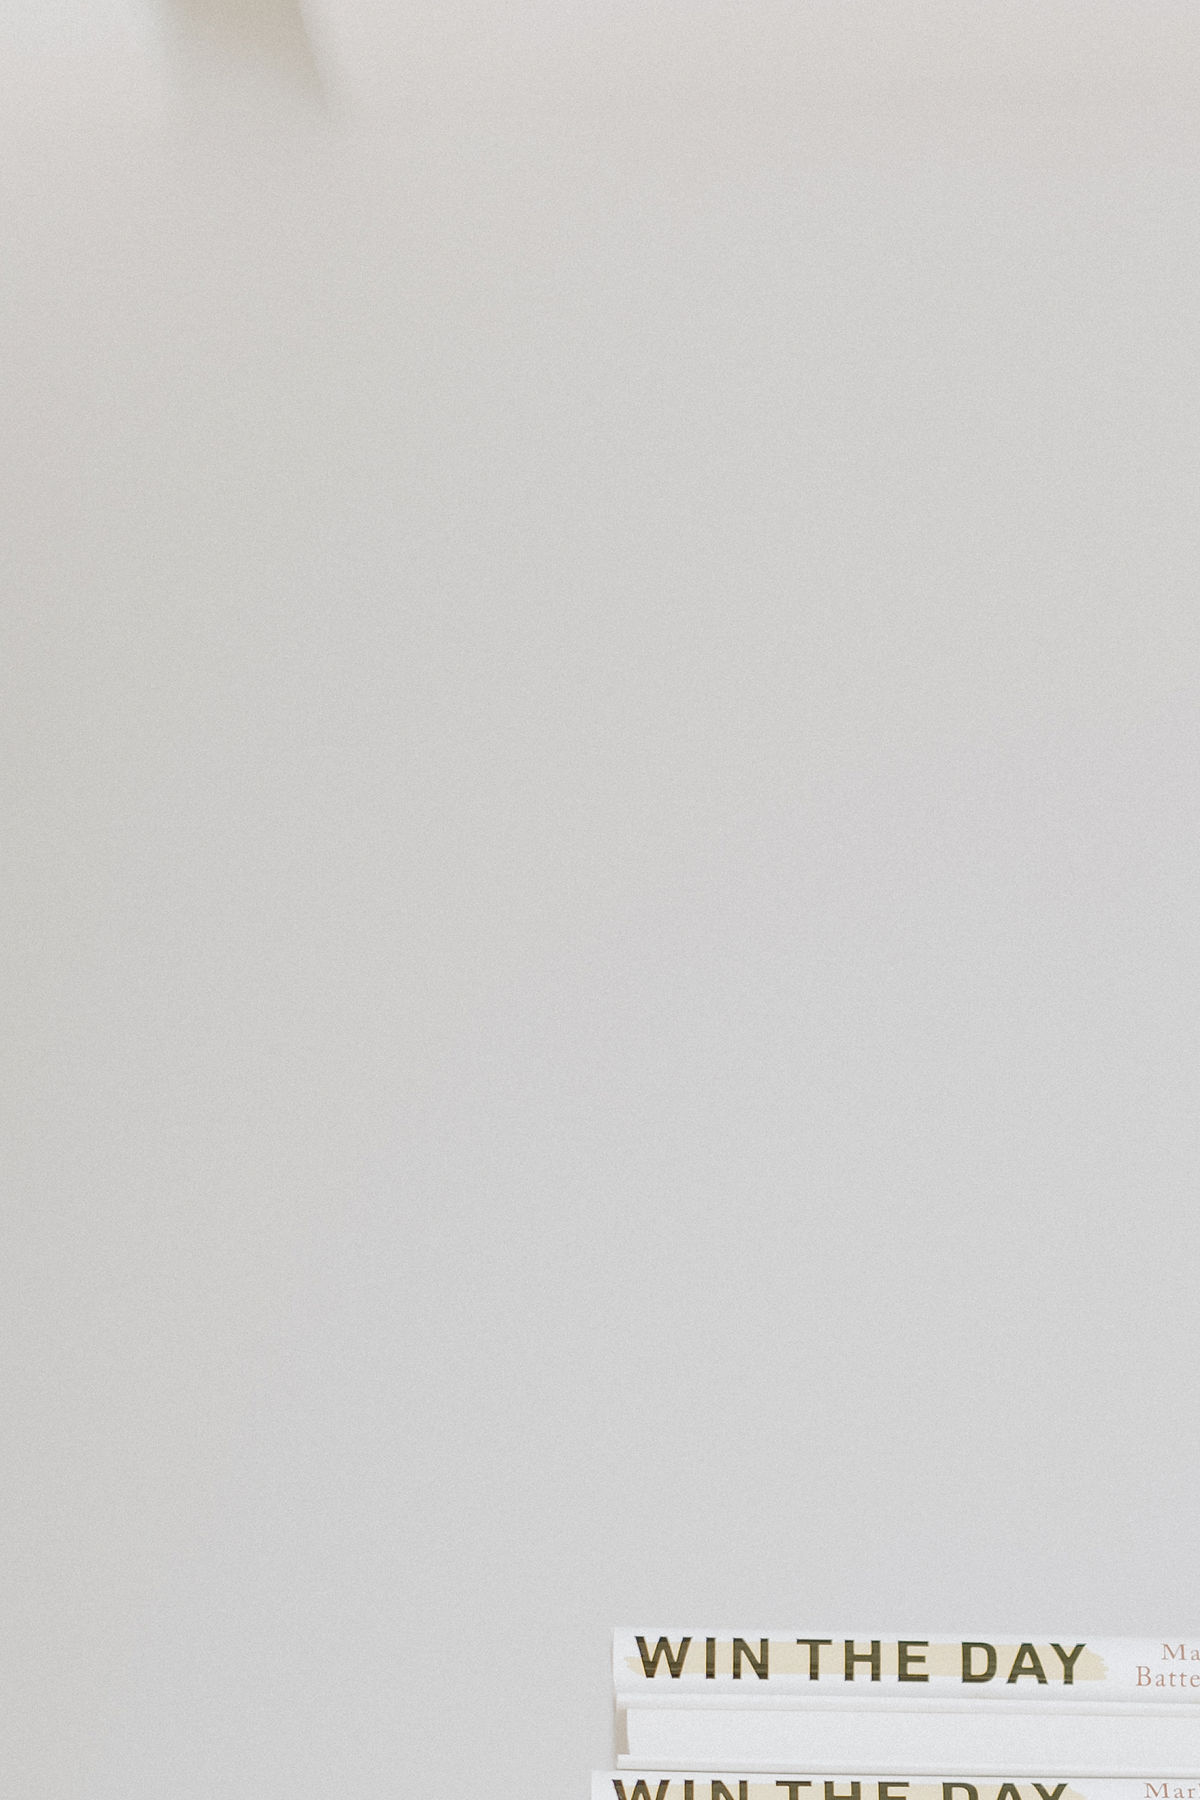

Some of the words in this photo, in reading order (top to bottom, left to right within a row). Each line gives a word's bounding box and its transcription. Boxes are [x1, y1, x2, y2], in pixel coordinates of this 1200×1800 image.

[635, 1636, 768, 1680] WIN
[797, 1639, 929, 1683] THE
[962, 1642, 1087, 1685] DAY
